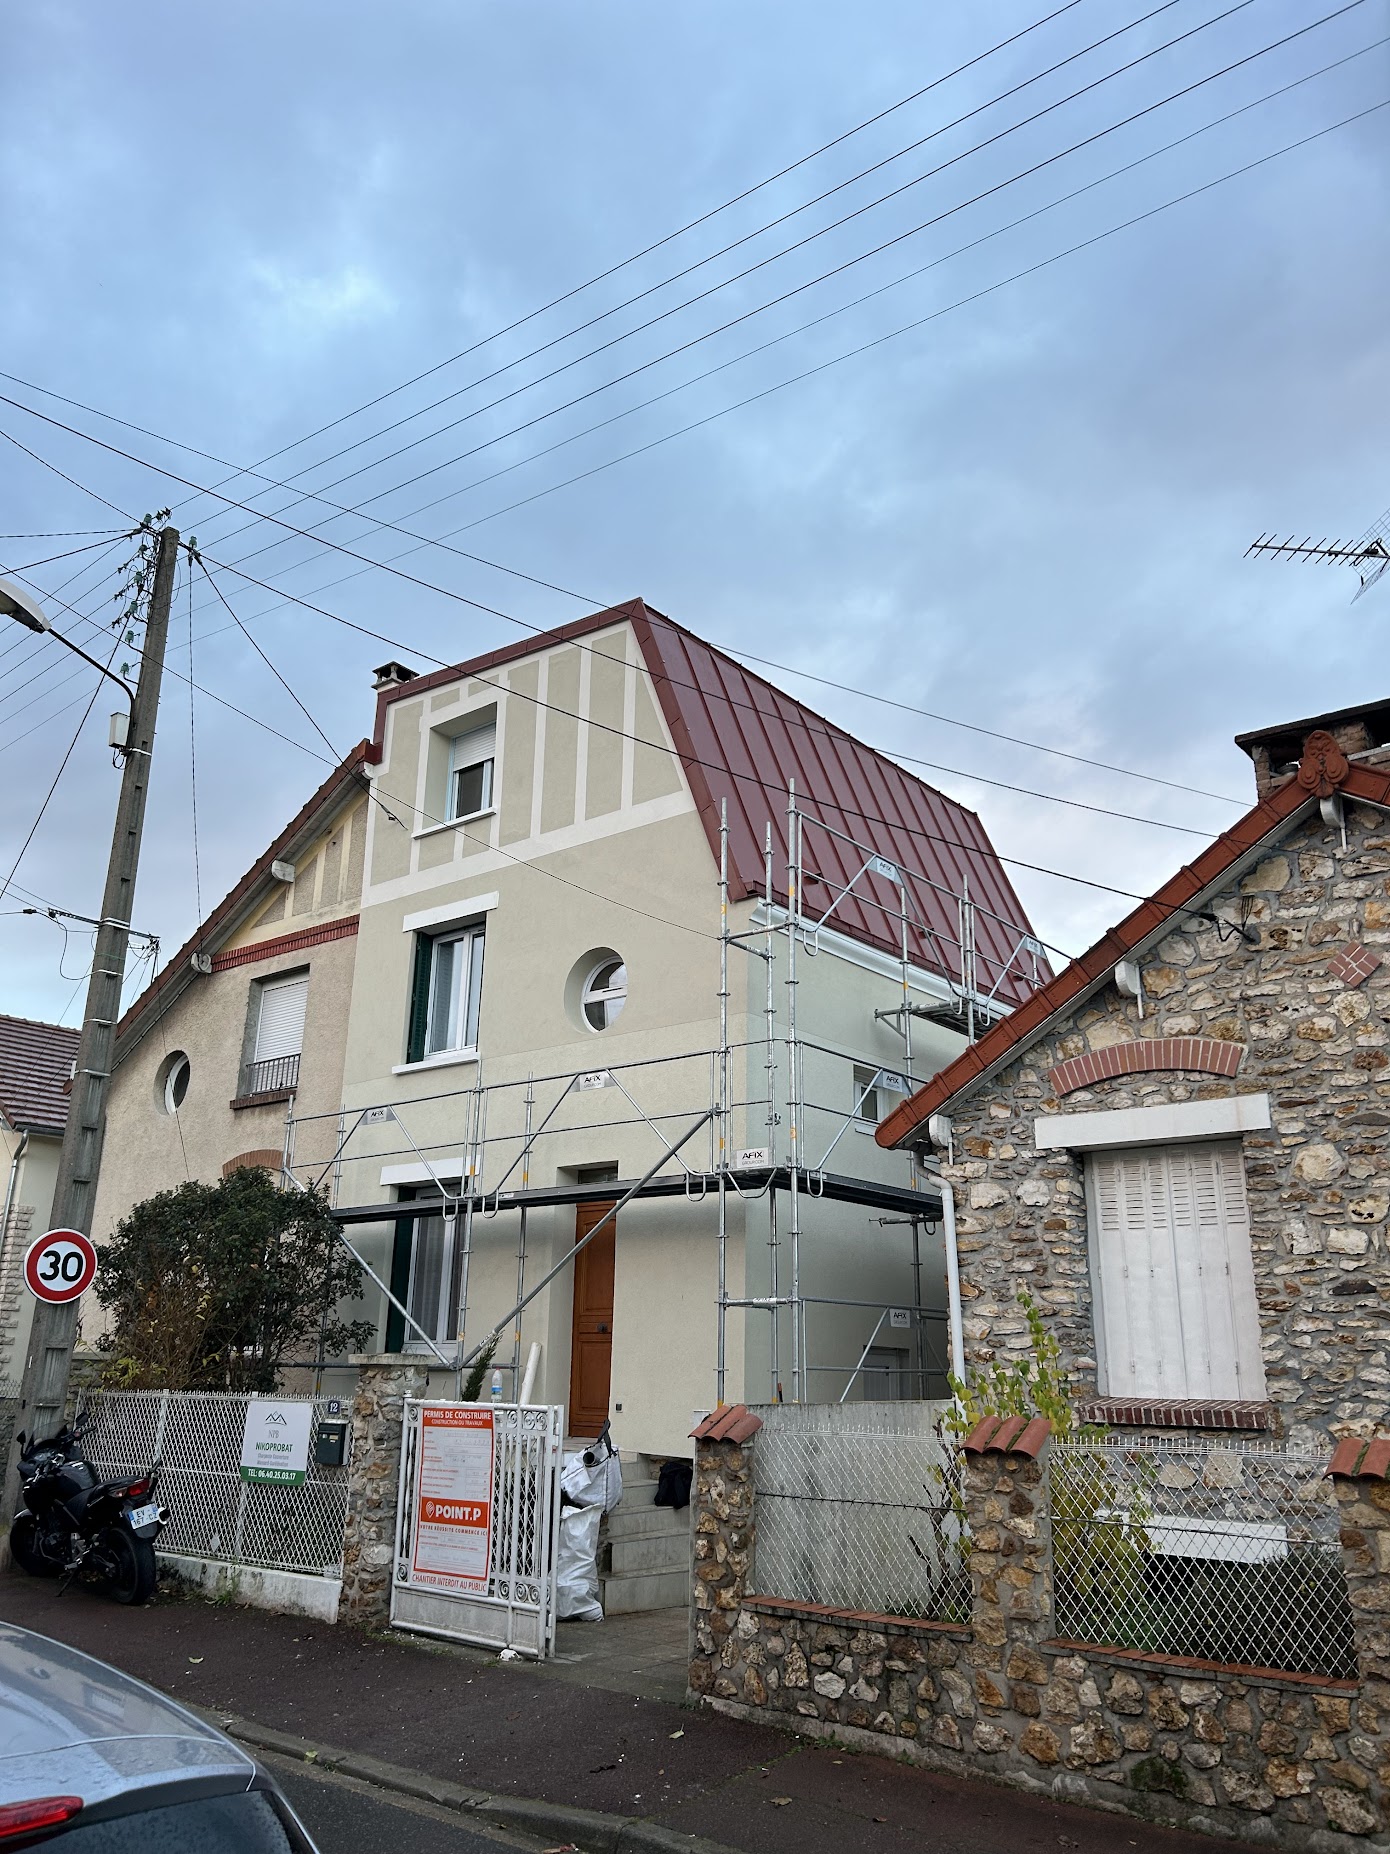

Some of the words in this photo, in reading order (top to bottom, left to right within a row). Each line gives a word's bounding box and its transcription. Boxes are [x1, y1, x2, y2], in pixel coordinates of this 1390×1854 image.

[584, 1075, 601, 1083] AFIX
[742, 1151, 763, 1160] AFIX
[39, 1250, 84, 1282] 30
[893, 1311, 907, 1319] AFIX
[330, 1402, 338, 1412] 12
[424, 1411, 444, 1419] PERMIS
[445, 1411, 454, 1419] DE
[454, 1411, 492, 1420] CONSTRUIRE
[255, 1442, 293, 1452] NIKOPROBAT
[248, 1469, 257, 1477] TEL:
[435, 1504, 482, 1521] POINT.P
[455, 1528, 480, 1536] COMMENCE
[412, 1574, 436, 1584] CHANTIER
[438, 1577, 459, 1588] INTERDIT
[460, 1580, 467, 1589] AU
[468, 1581, 487, 1592] PUBLIC
